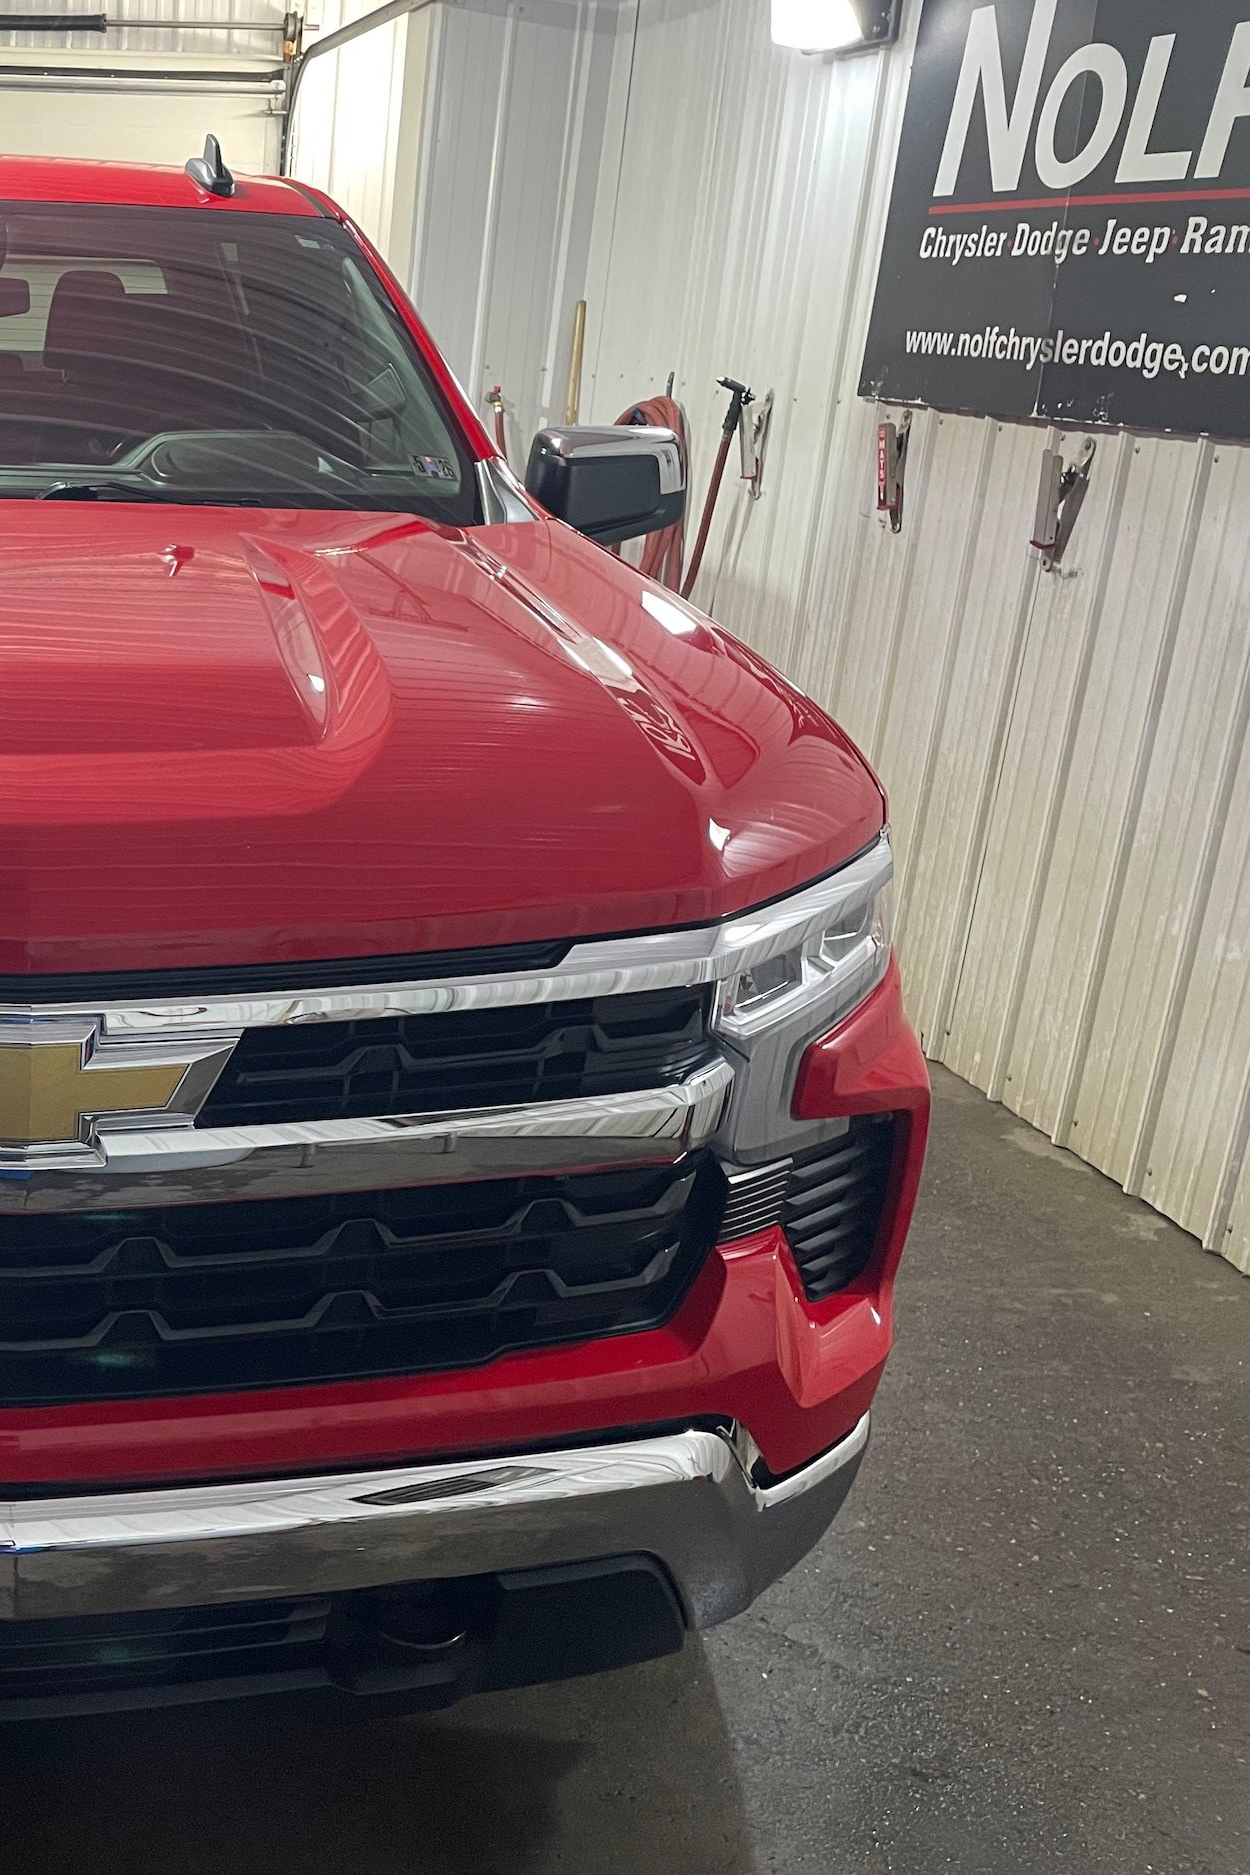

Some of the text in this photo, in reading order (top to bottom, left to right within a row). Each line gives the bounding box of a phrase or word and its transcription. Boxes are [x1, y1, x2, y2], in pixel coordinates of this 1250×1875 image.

[919, 224, 1008, 266] Chrysler
[1010, 222, 1091, 264] Dodge
[1098, 218, 1172, 263] Jeep
[878, 439, 886, 479] MATS
